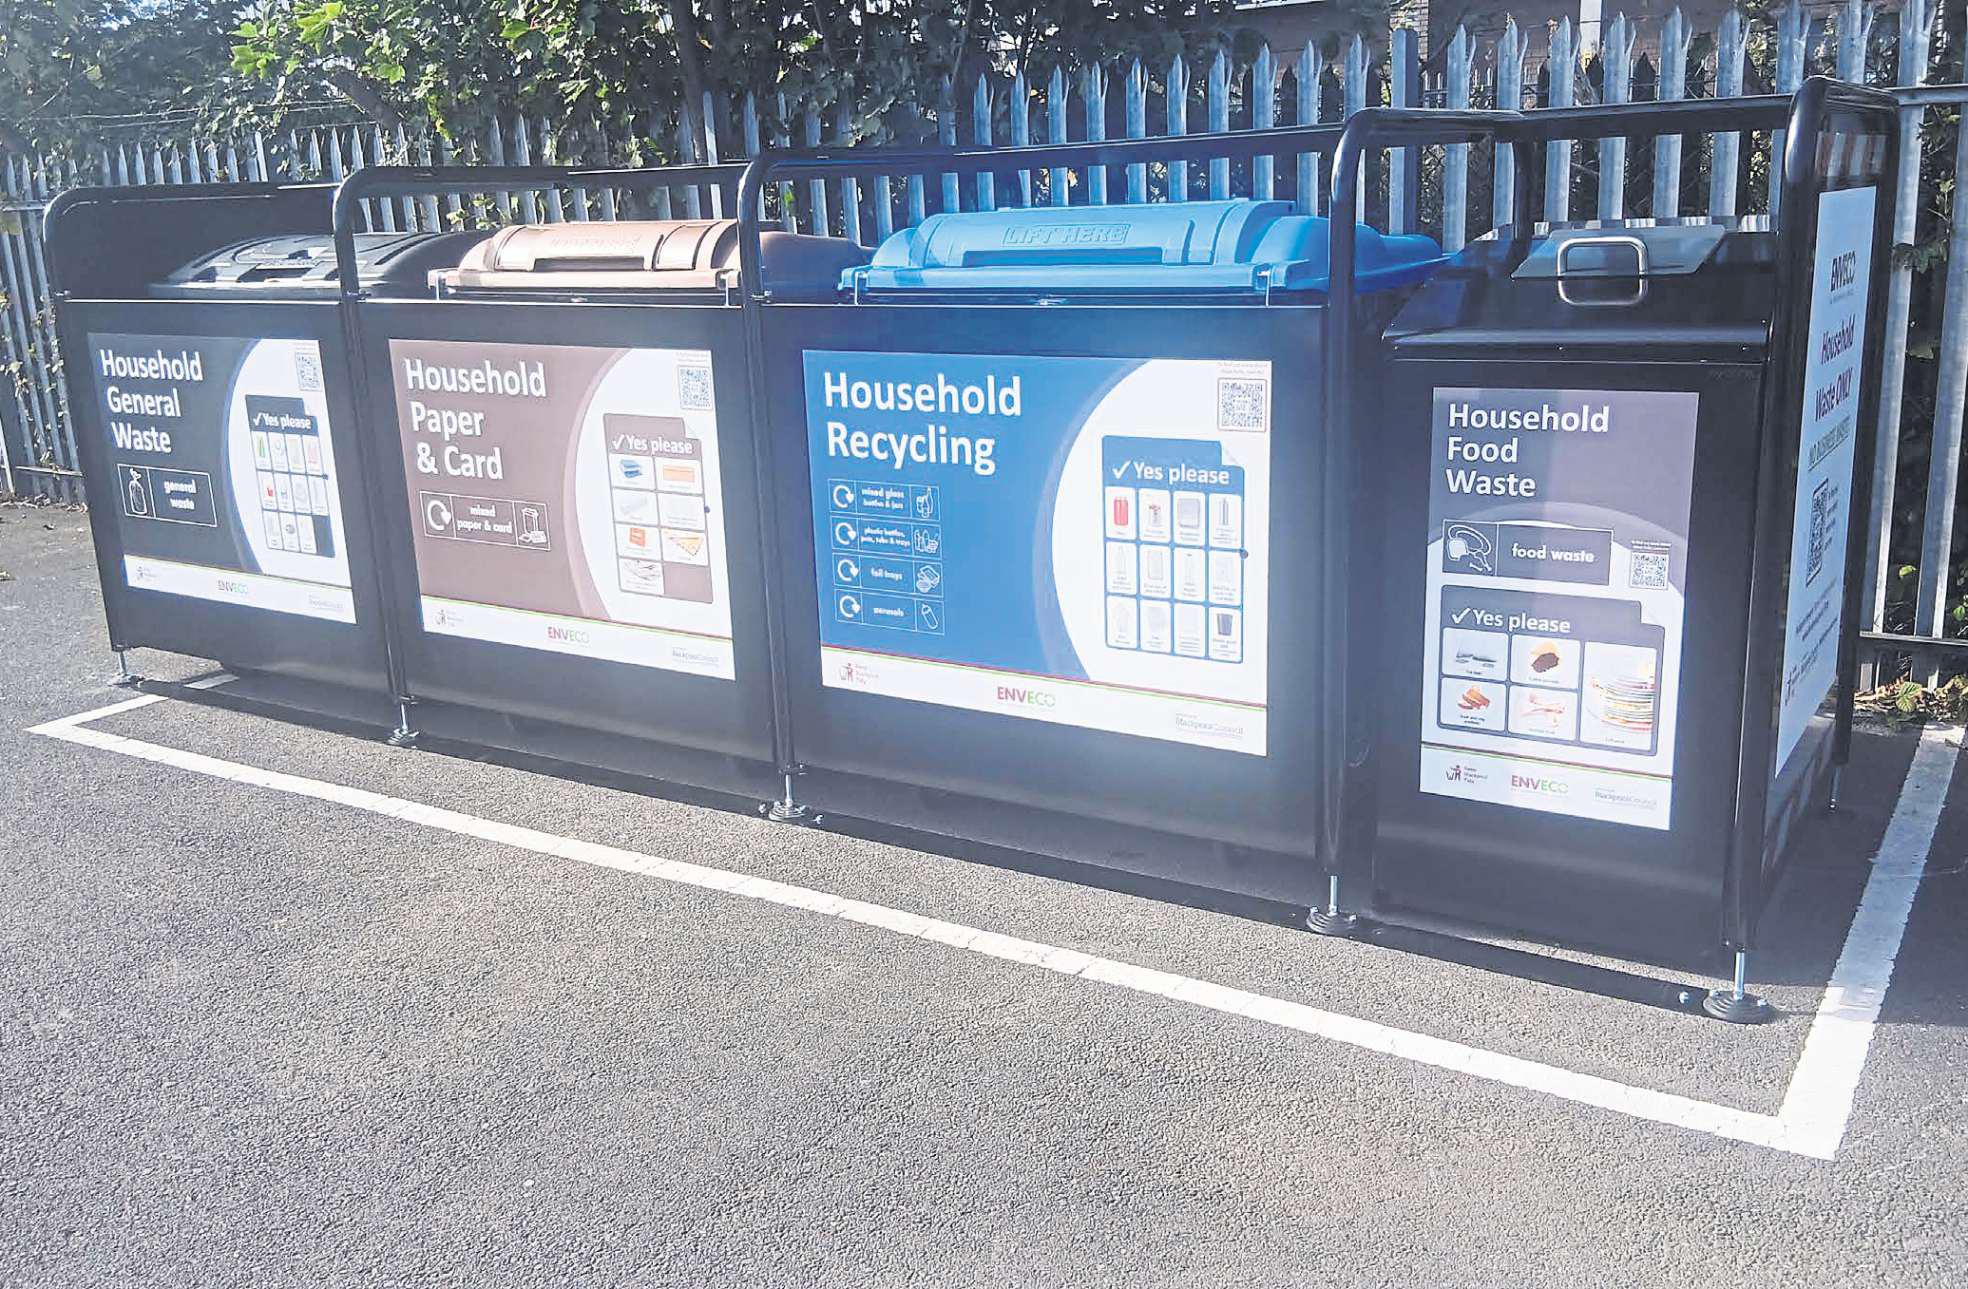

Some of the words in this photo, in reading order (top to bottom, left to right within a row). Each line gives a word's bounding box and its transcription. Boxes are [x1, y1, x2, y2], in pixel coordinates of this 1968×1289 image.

[1009, 227, 1057, 244] LIFT
[1063, 225, 1126, 242] HERE
[1821, 314, 1856, 364] Household
[100, 349, 204, 381] Household
[404, 358, 547, 397] Household
[106, 385, 182, 417] General
[824, 371, 1022, 417] Household
[1815, 384, 1836, 422] Waste
[263, 412, 279, 427] Yes
[280, 413, 312, 430] please
[410, 401, 485, 441] Paper
[1448, 403, 1610, 433] Household
[111, 422, 172, 453] Waste
[624, 434, 648, 452] Yes
[650, 435, 694, 455] please
[826, 421, 996, 476] Recycling
[1447, 436, 1519, 463] Food
[416, 441, 439, 474] &
[444, 445, 504, 480] Card
[1133, 461, 1164, 480] Yes
[1168, 463, 1230, 485] please
[1446, 468, 1537, 498] Waste
[1511, 542, 1547, 560] food
[1551, 549, 1596, 564] waste
[547, 625, 591, 644] ENVECO
[1473, 609, 1504, 627] Yes
[1508, 612, 1571, 633] please
[997, 685, 1056, 708] ENVECO
[1511, 774, 1569, 795] ENVECO
